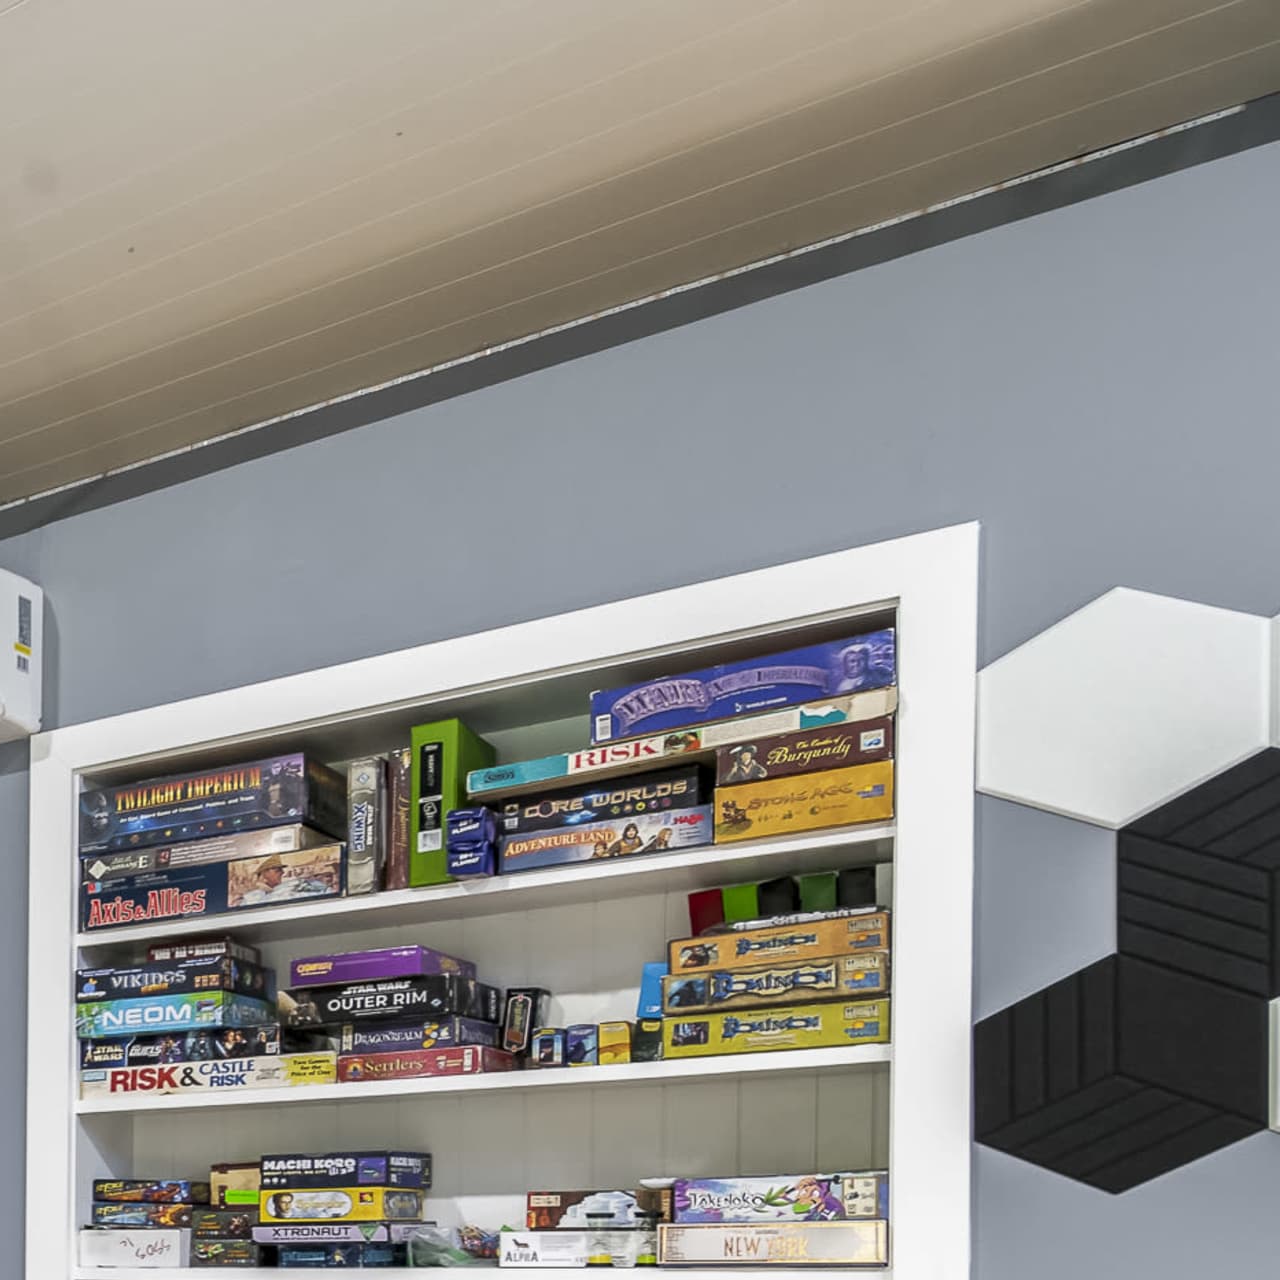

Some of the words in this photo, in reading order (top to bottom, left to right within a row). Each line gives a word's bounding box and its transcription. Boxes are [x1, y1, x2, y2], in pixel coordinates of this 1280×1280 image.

[574, 739, 658, 770] RISK
[766, 735, 853, 767] Burgundy
[115, 780, 185, 812] TWILIGHT
[186, 766, 263, 799] IMPERIUM
[524, 799, 585, 819] CORE
[592, 780, 689, 807] WORLDS
[504, 833, 577, 857] ADVENTURE
[580, 829, 615, 845] LAND
[88, 896, 134, 928] Axis
[145, 888, 207, 919] Allies
[111, 970, 187, 989] VIKINGS
[327, 994, 389, 1012] OUTER
[393, 990, 428, 1006] RIM
[101, 1004, 192, 1027] NEOM
[199, 1059, 255, 1076] CASTLE
[110, 1066, 179, 1093] RISK
[180, 1067, 202, 1087] &
[209, 1073, 246, 1088] RISK
[263, 1160, 312, 1171] MACHI
[314, 1158, 356, 1170] KORO
[272, 1226, 352, 1237] XTRONAUT
[723, 1236, 759, 1257] NEW
[766, 1236, 809, 1257] YORK
